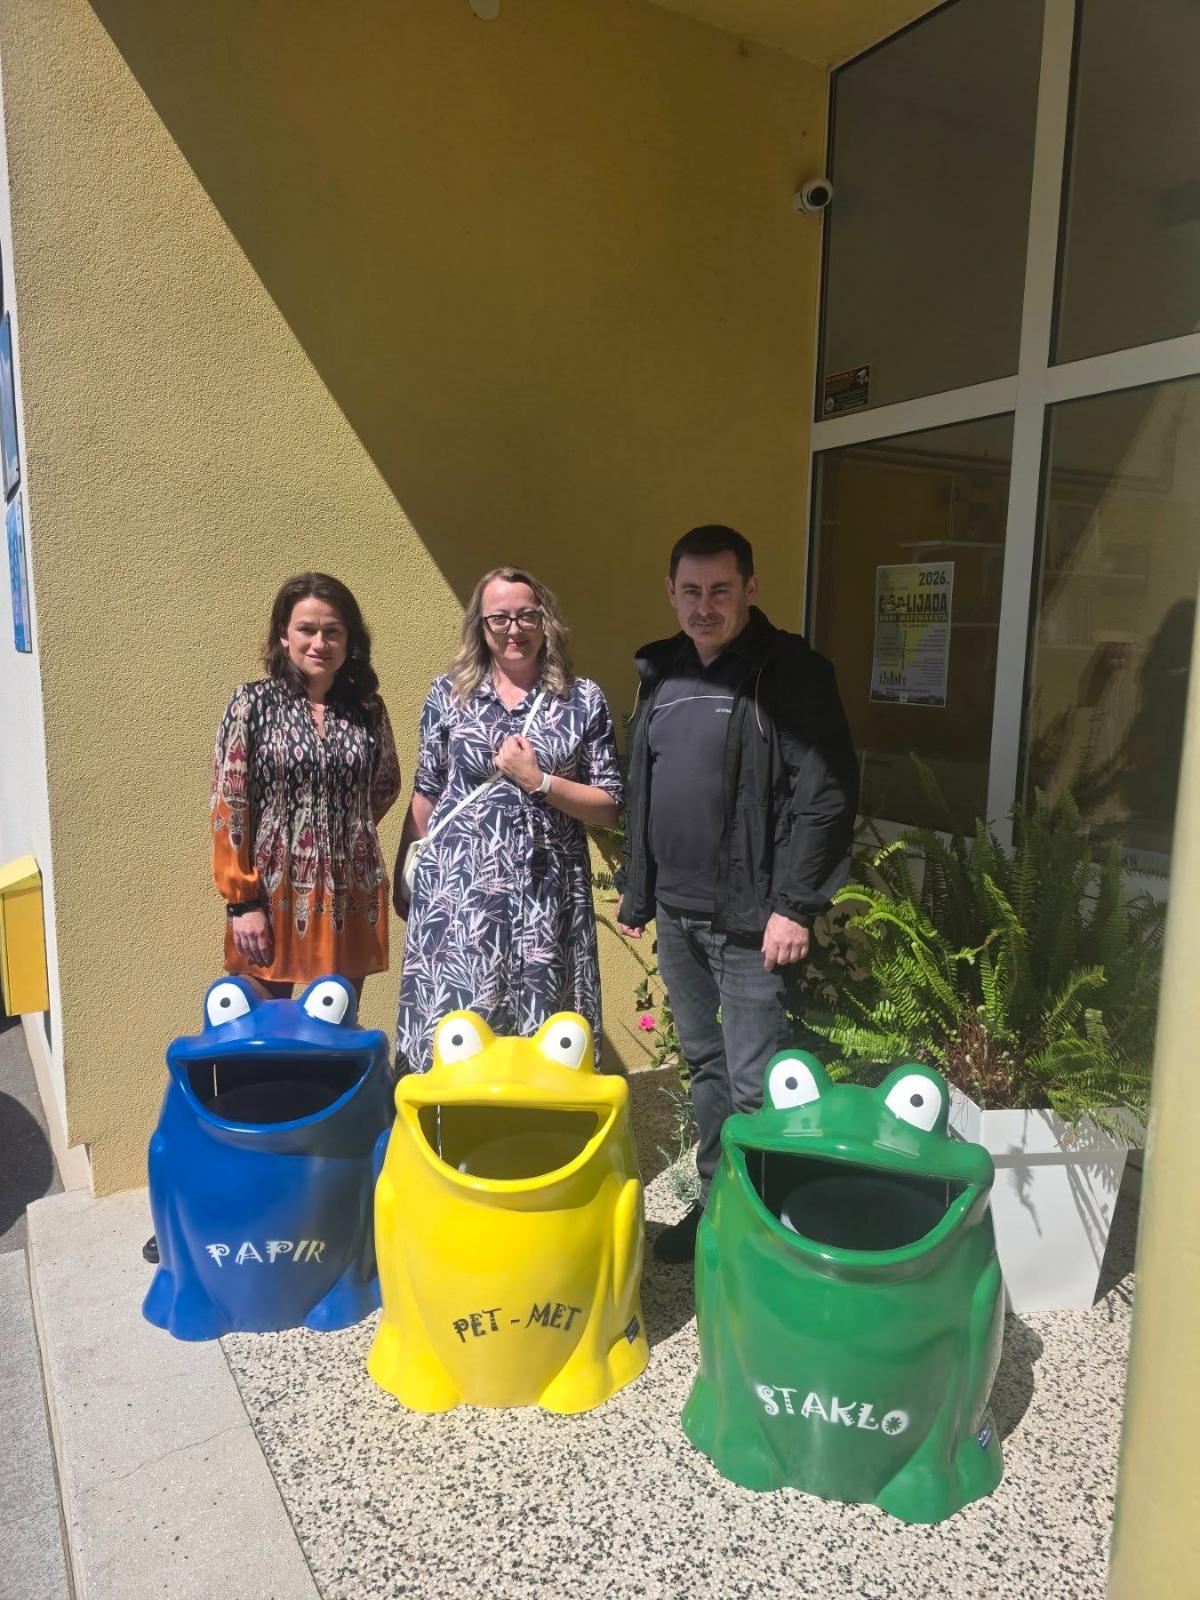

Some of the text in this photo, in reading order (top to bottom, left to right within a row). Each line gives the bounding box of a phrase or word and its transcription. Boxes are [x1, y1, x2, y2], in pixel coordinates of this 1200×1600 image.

[918, 570, 950, 586] 2026.
[205, 1239, 327, 1268] PAPIR
[452, 1307, 502, 1343] PET
[524, 1302, 583, 1332] MET
[755, 1384, 909, 1436] STAKLO
